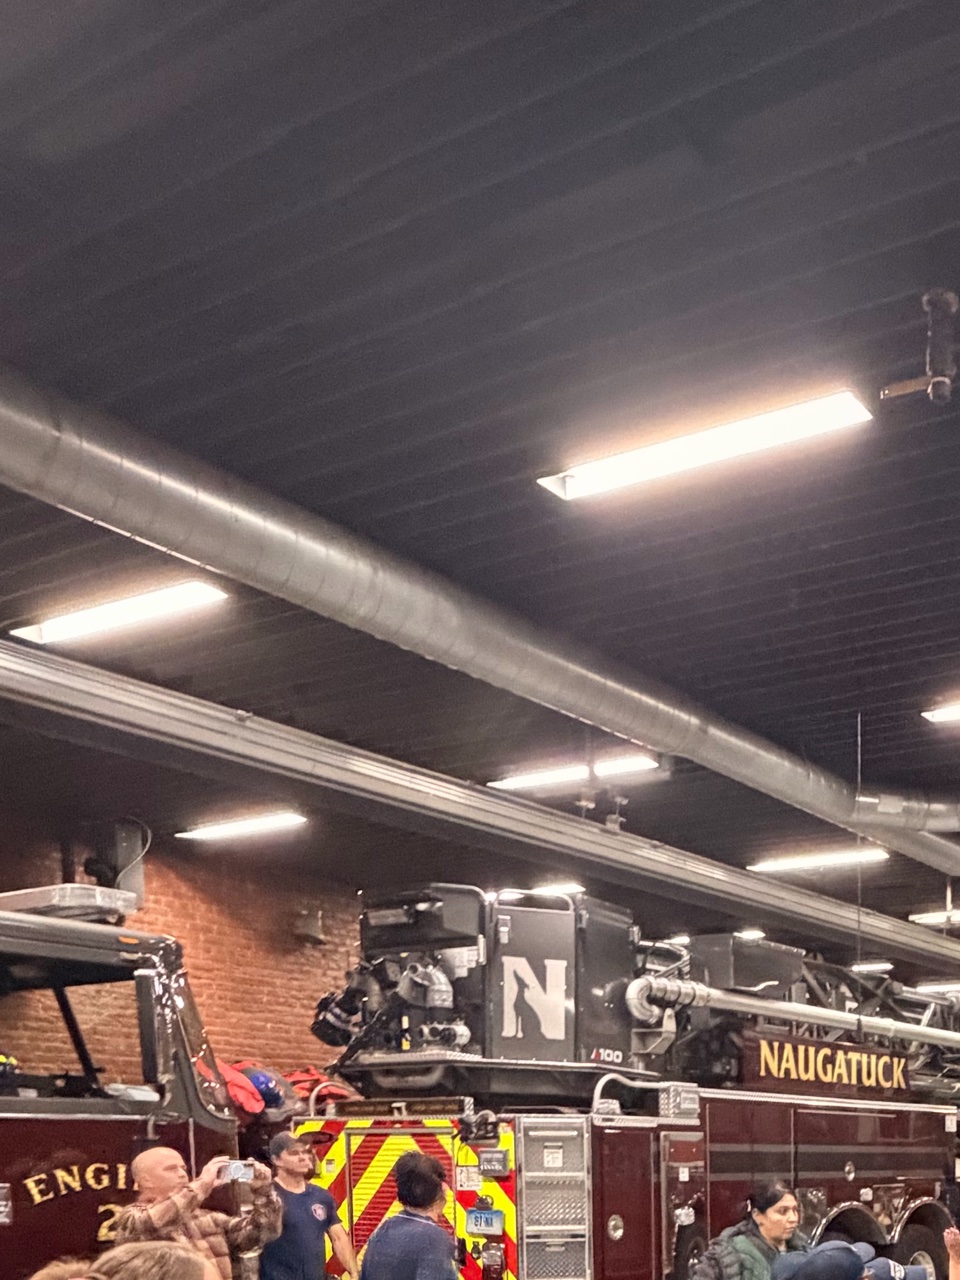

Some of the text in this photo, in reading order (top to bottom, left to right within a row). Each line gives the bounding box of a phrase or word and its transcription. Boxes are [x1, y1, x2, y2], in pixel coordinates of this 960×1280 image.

[501, 955, 568, 1040] N
[759, 1039, 907, 1090] NAUGATUCK
[22, 1163, 140, 1206] ENGI
